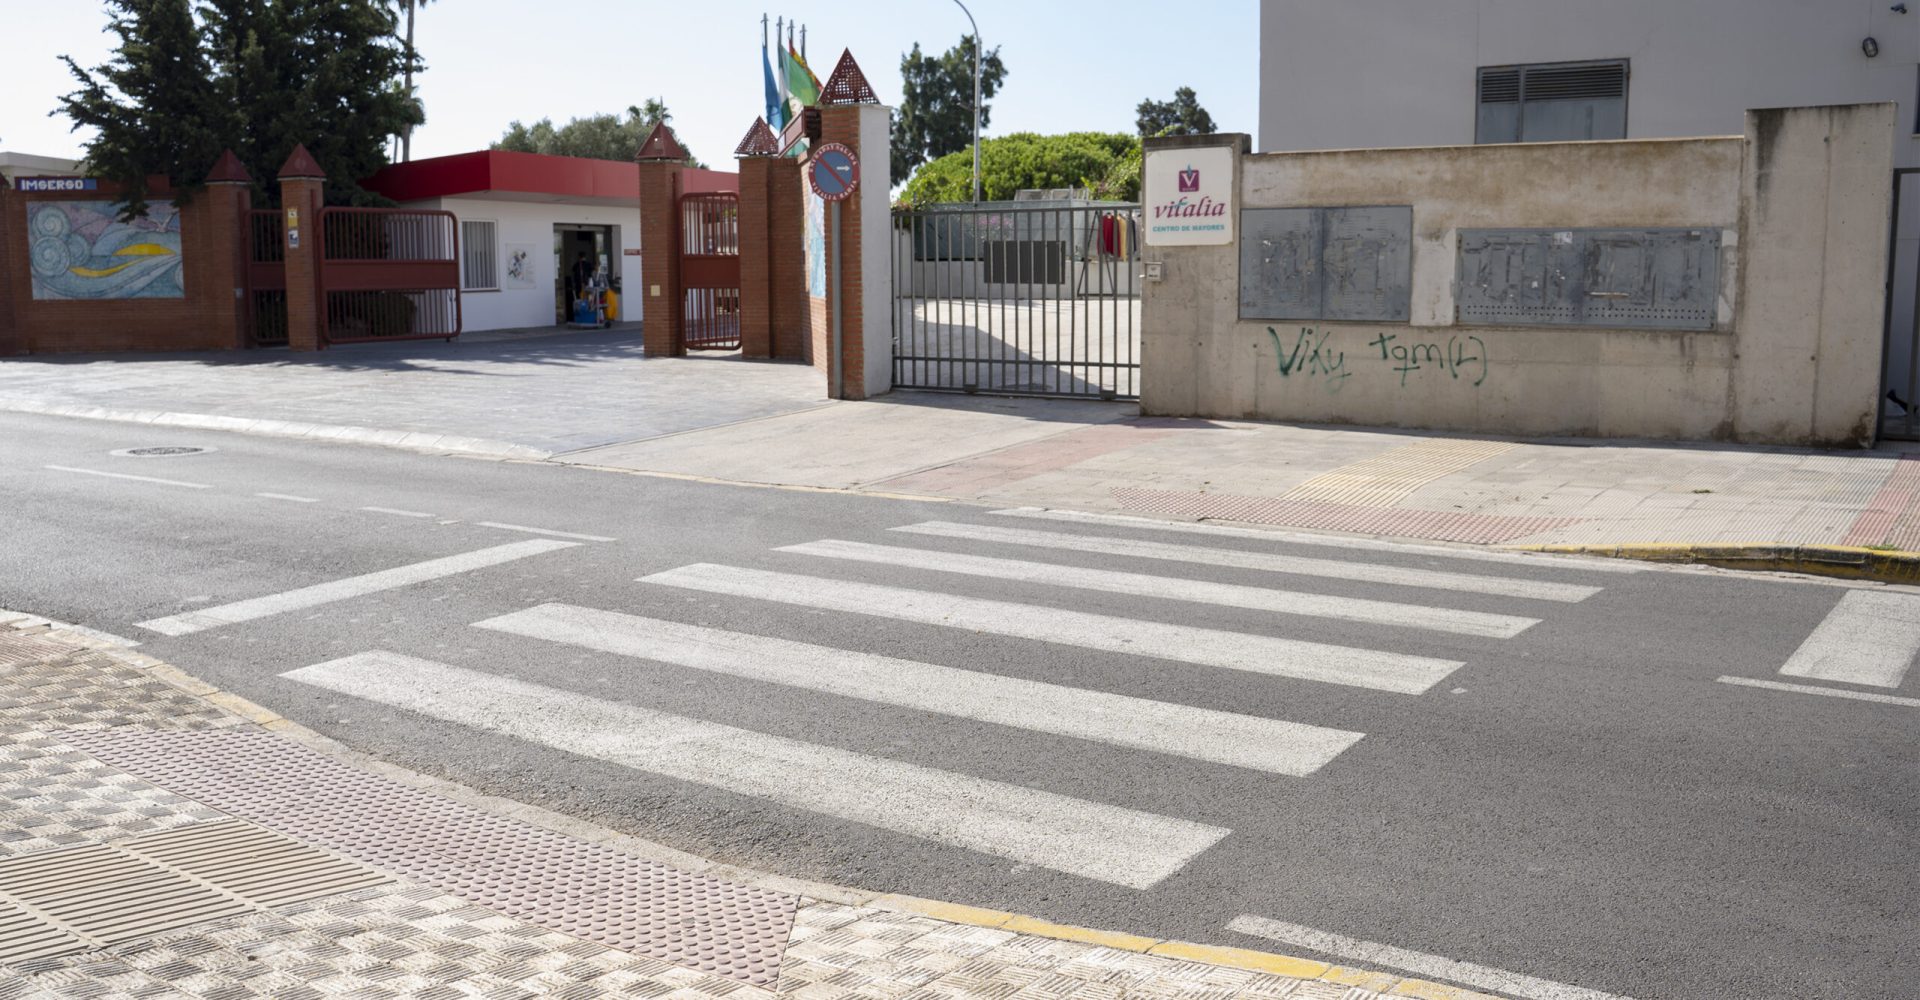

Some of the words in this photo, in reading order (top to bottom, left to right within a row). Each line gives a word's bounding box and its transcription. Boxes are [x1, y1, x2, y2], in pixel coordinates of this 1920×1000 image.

[21, 179, 84, 191] IMSERSO
[1154, 195, 1226, 219] vitalia
[1152, 225, 1180, 233] CENTRO
[1181, 224, 1191, 232] DE
[1192, 223, 1225, 232] MAYORES
